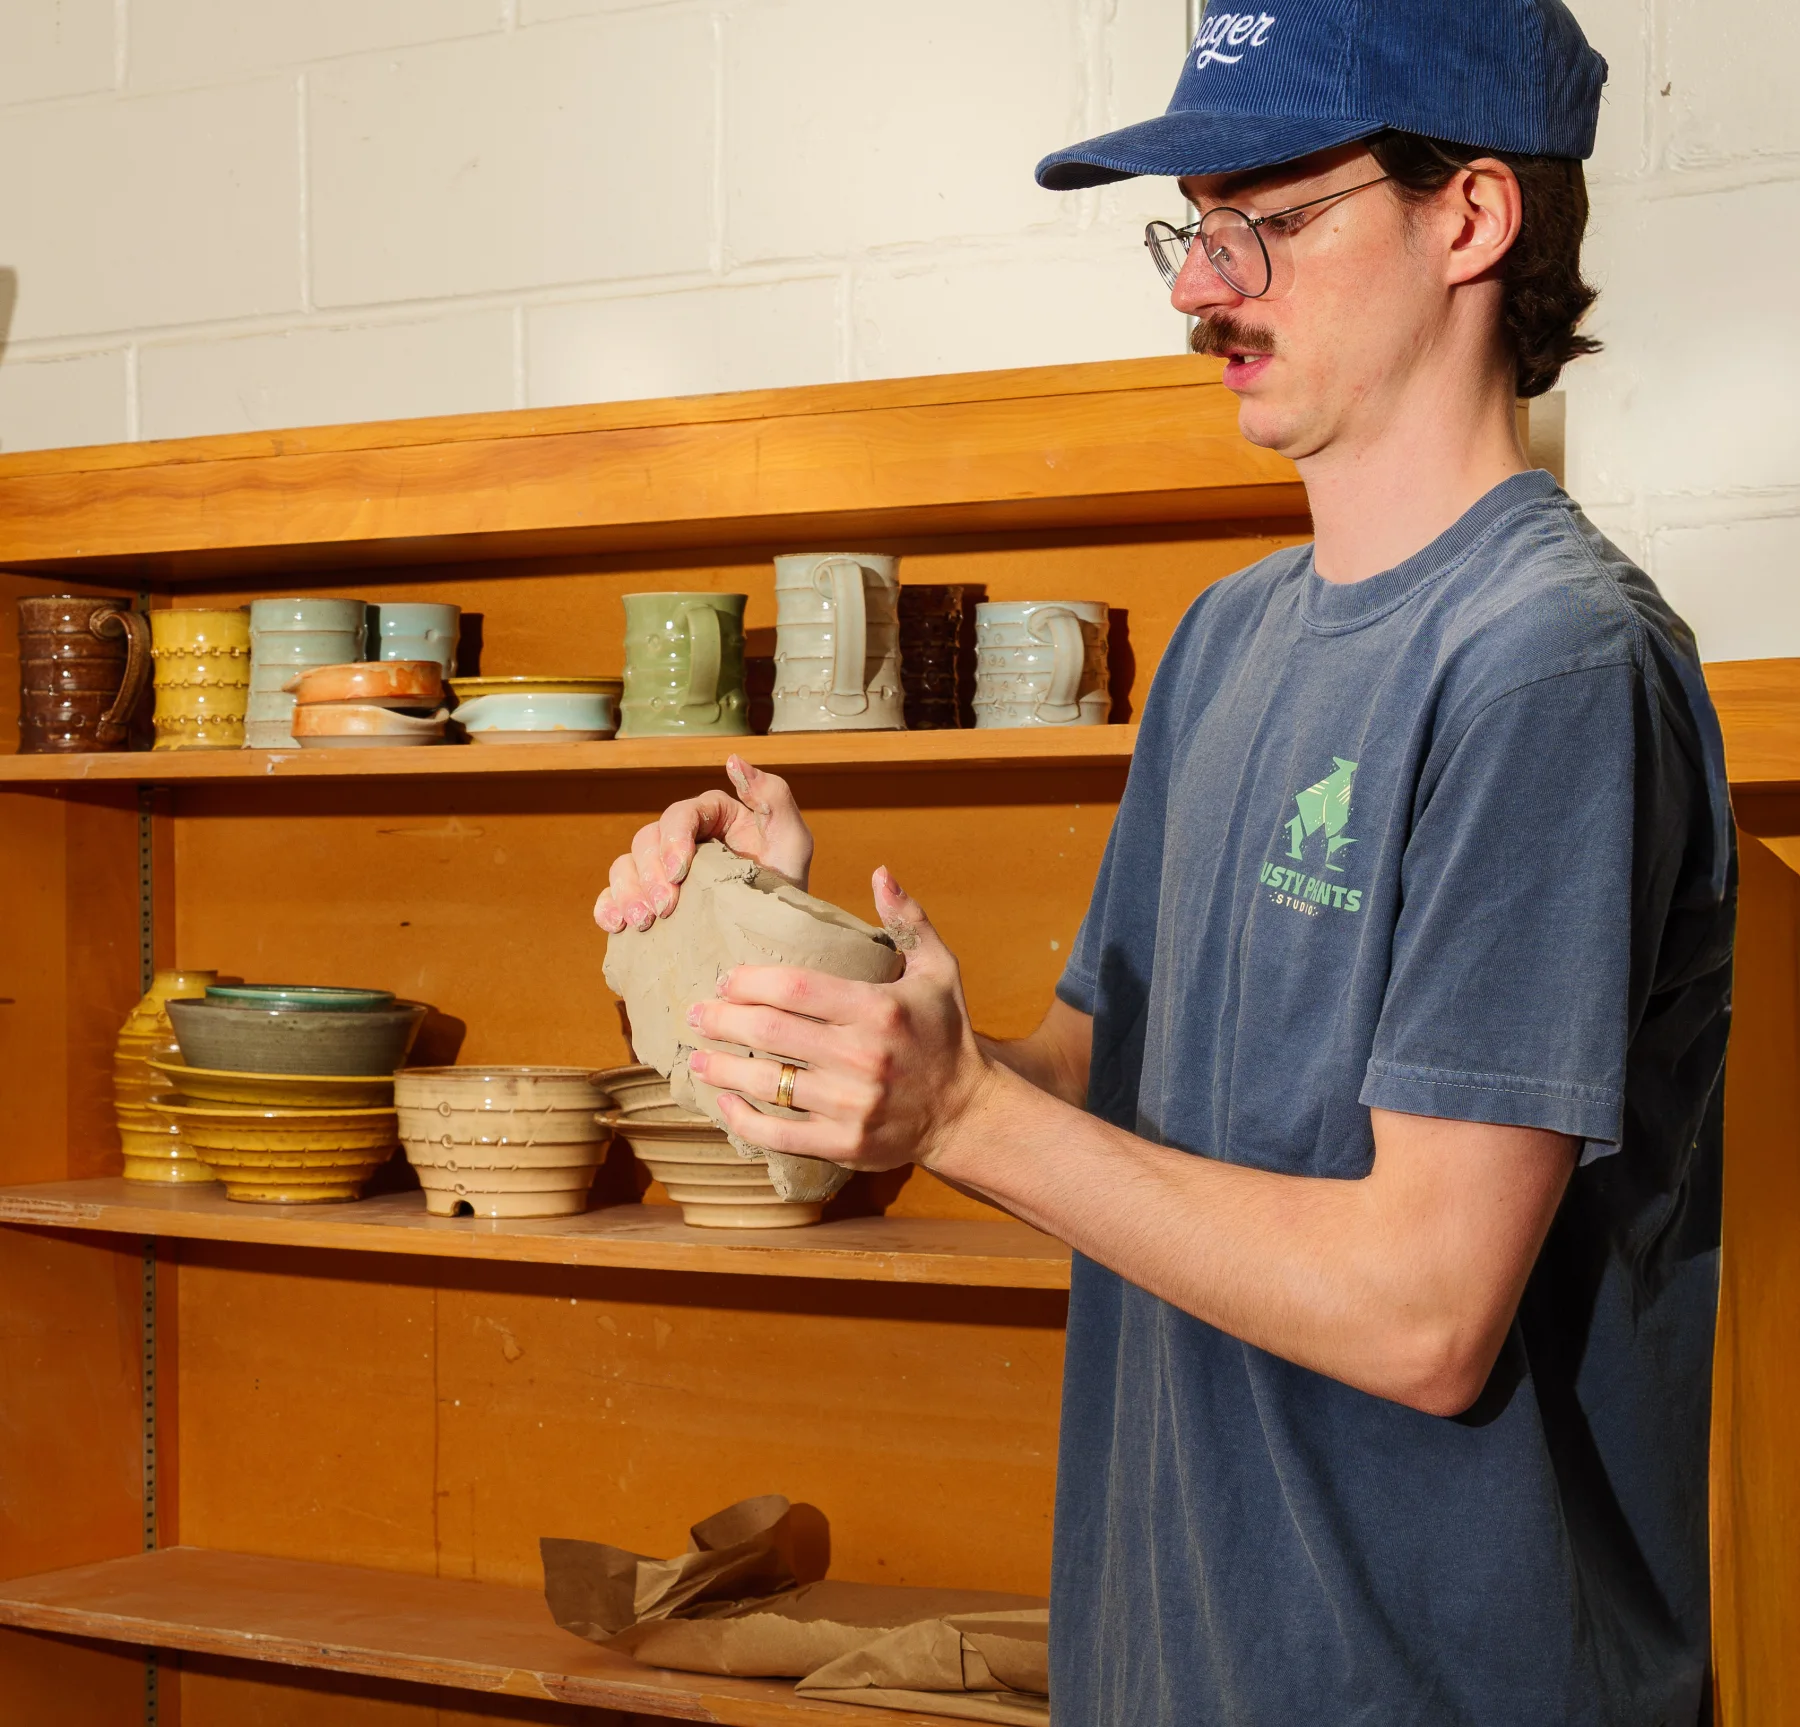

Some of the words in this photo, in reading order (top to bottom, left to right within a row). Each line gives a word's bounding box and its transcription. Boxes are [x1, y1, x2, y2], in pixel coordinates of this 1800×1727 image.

[1194, 11, 1276, 70] ager
[1260, 861, 1307, 896] USTY
[1302, 877, 1363, 912] PANTS
[1275, 893, 1313, 916] STUDIO
